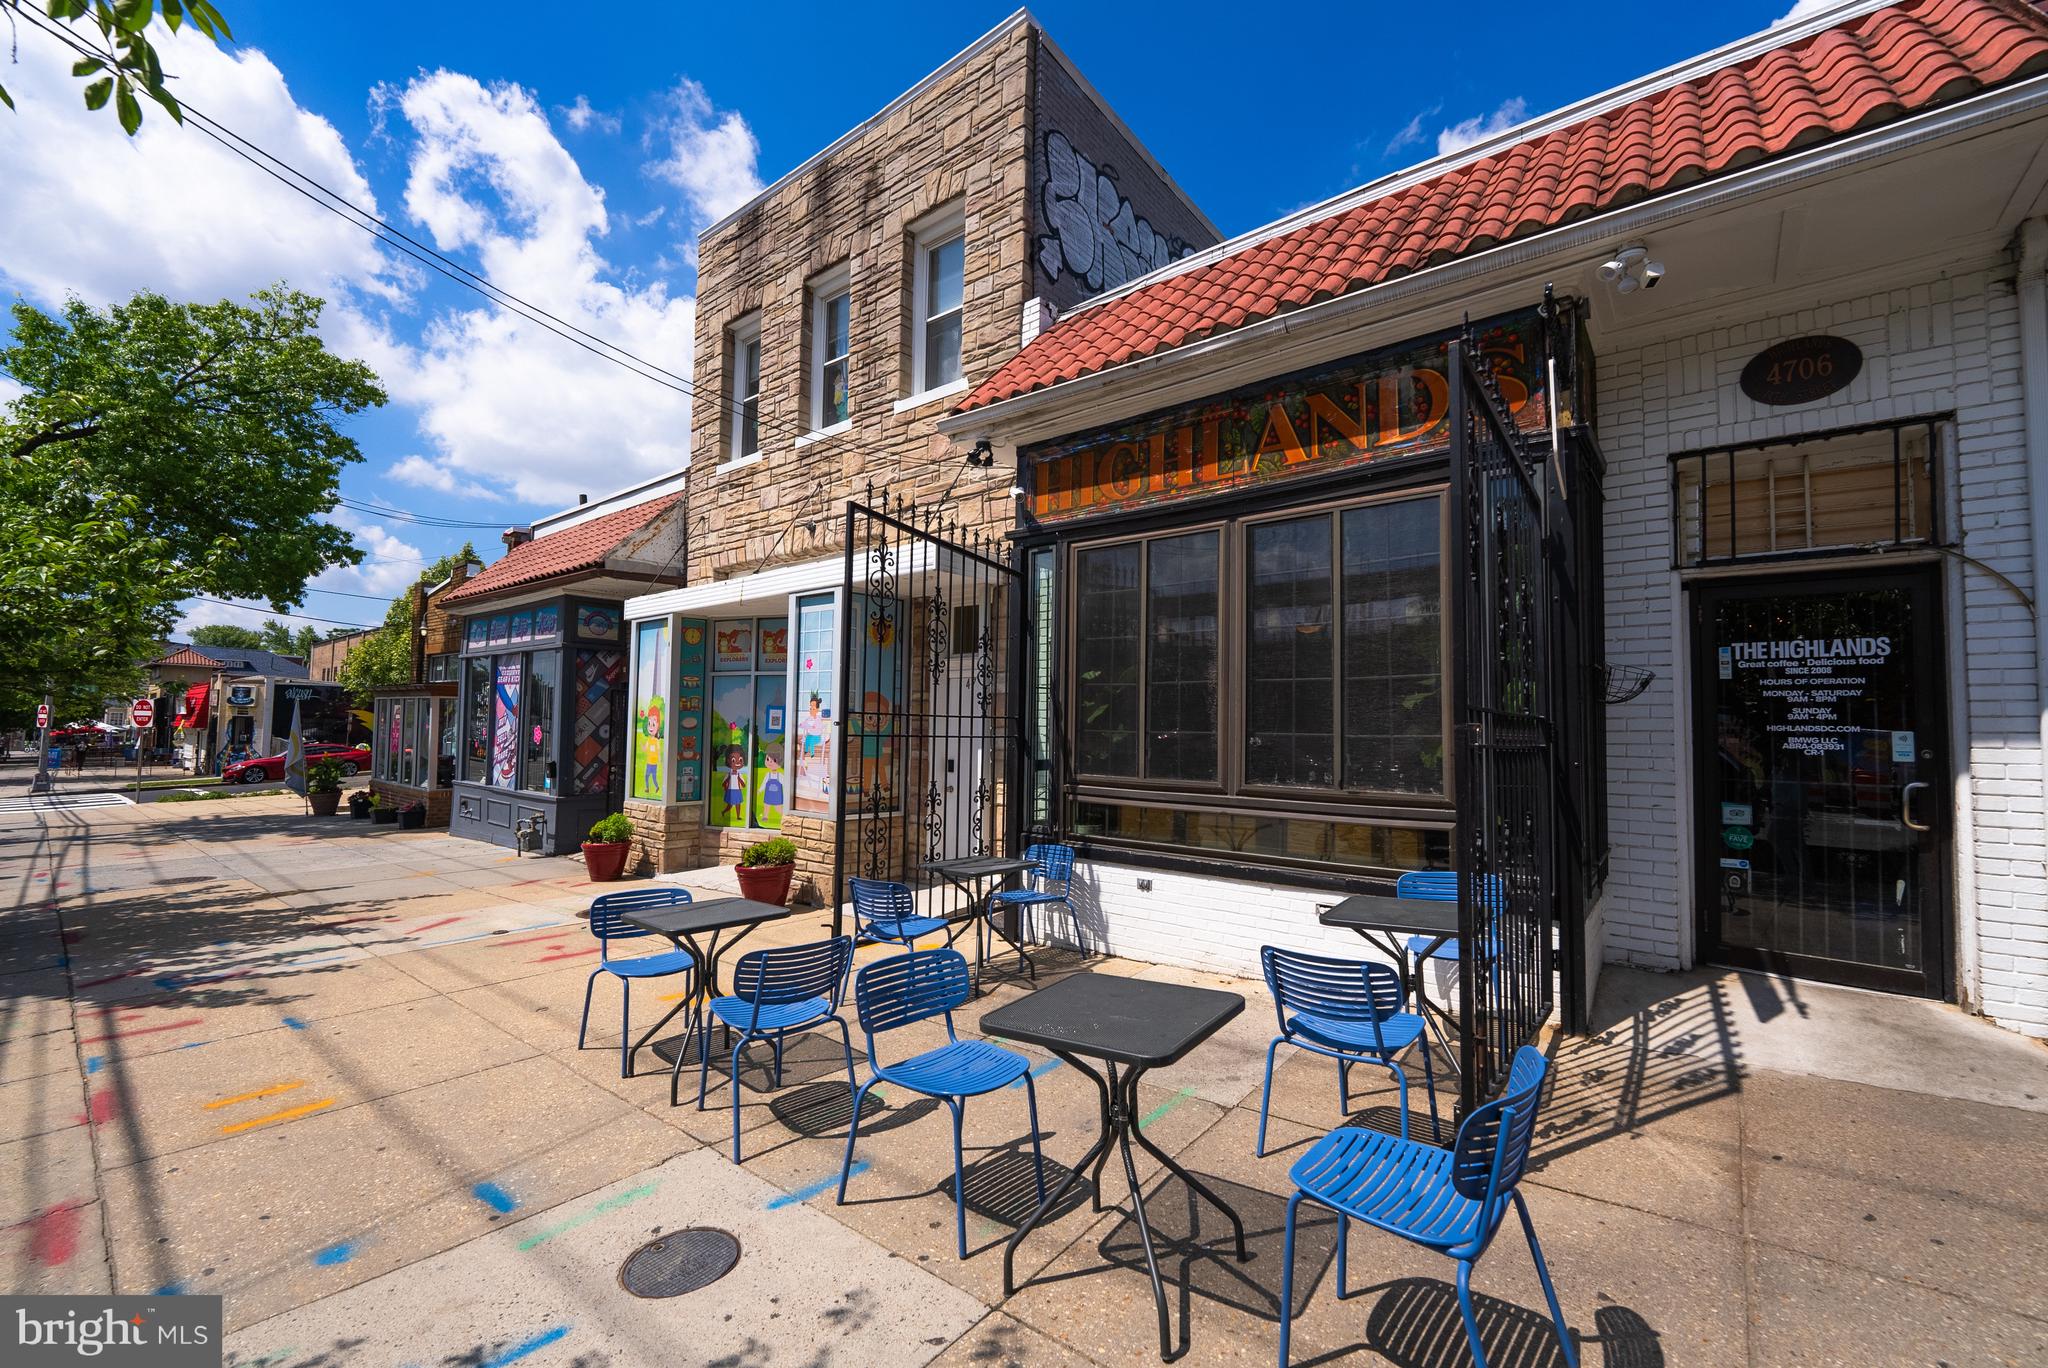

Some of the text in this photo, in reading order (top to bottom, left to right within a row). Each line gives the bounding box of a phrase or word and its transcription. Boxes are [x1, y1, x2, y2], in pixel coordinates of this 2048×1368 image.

[1765, 353, 1833, 385] 4706
[1731, 637, 1891, 660] THE HIGHLANDS
[1737, 661, 1766, 669] Great
[1767, 659, 1799, 668] coffee
[1807, 657, 1856, 666] Delicious
[1858, 656, 1884, 665] food
[1785, 666, 1832, 675] SINCE 2008
[1759, 678, 1792, 686] HOURS
[1809, 677, 1866, 685] OPERATION
[1811, 689, 1862, 697] SATURDAY
[1766, 725, 1861, 733] HIGHLANDSDC.COM
[1782, 743, 1845, 751] ABRA-083931
[1729, 833, 1748, 843] FAVE
